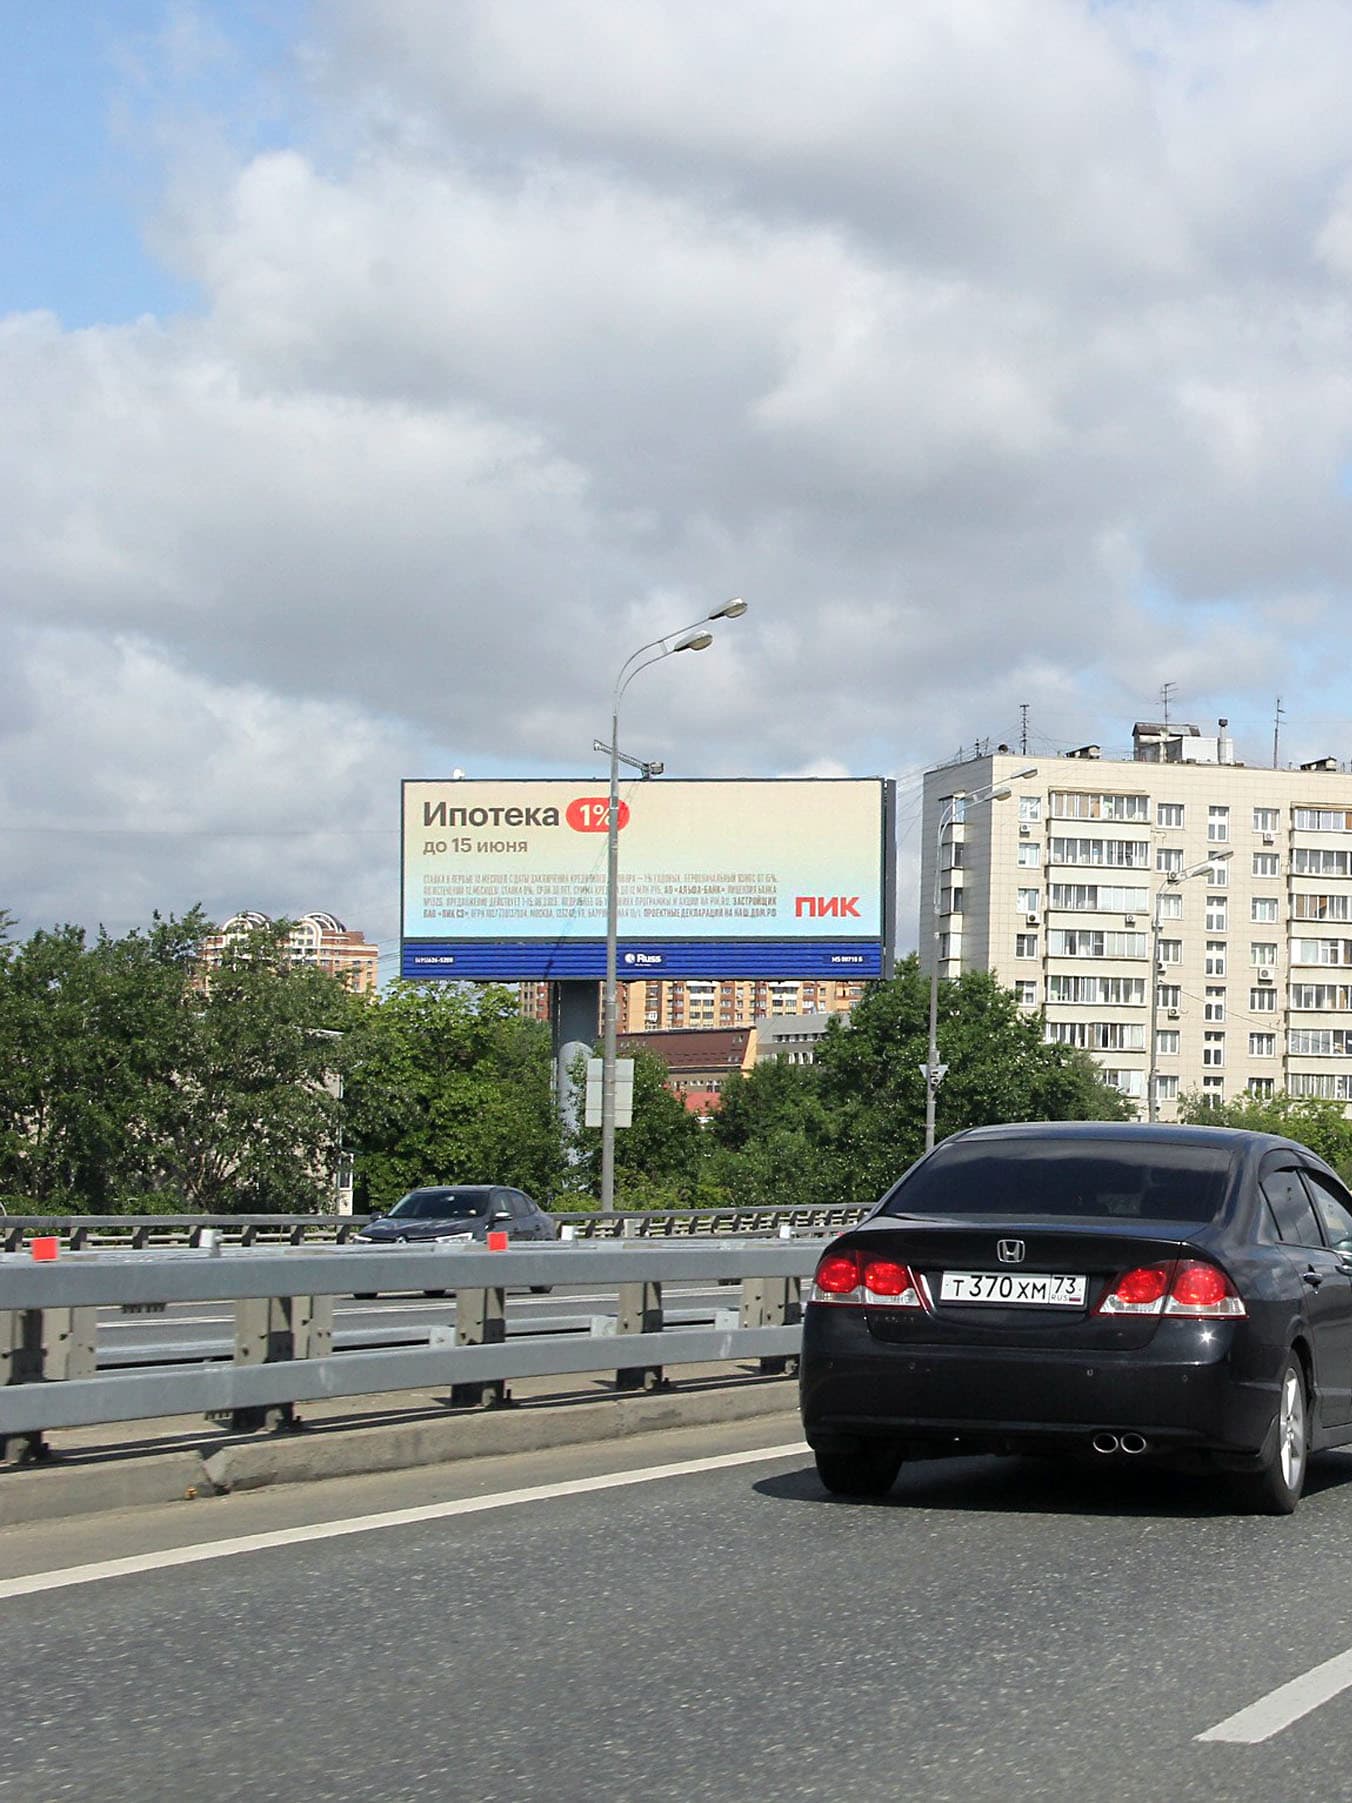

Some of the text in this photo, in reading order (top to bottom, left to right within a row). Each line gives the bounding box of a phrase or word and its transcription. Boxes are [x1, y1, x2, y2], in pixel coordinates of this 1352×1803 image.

[423, 801, 610, 827] Ипотека 1%
[423, 838, 528, 855] до 15 июня
[795, 896, 862, 917] ПИК
[636, 953, 662, 963] Russ
[1053, 1276, 1077, 1294] 73
